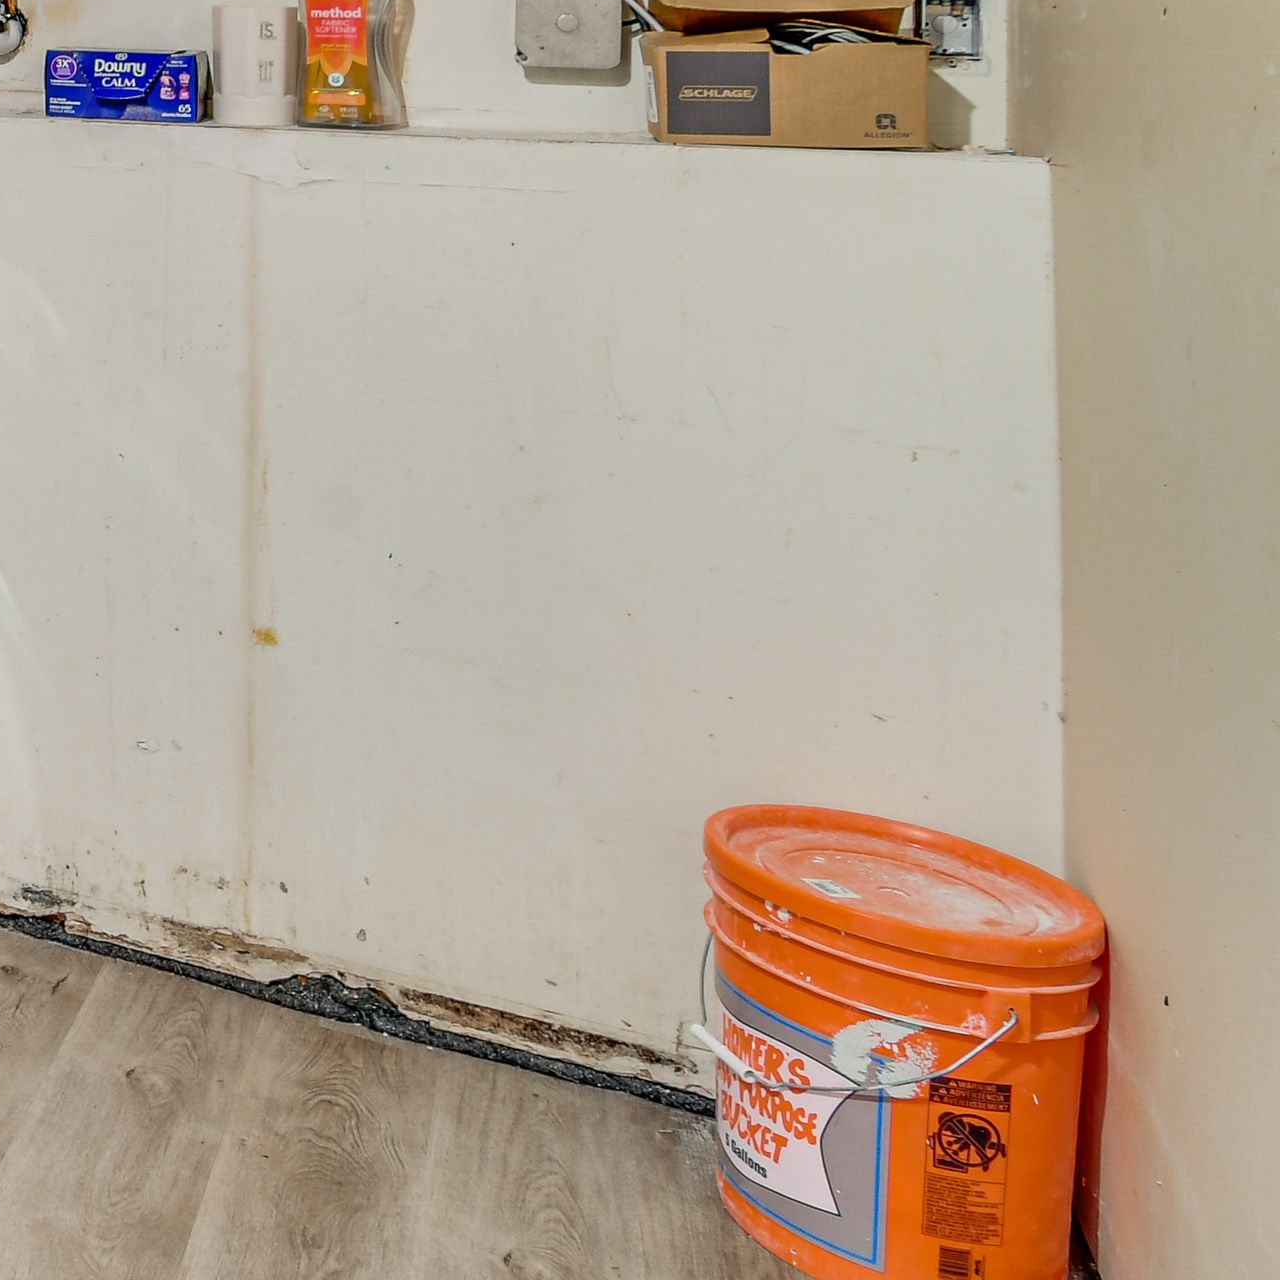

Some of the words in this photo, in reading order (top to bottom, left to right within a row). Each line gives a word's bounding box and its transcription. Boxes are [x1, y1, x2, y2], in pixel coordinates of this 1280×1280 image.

[310, 7, 362, 18] method
[314, 26, 357, 34] SOFTENER
[94, 59, 147, 77] Downy
[102, 77, 136, 87] CALM
[682, 89, 754, 98] SCHLAGE
[178, 105, 191, 113] 65
[863, 131, 911, 139] ALLEGION
[722, 1012, 811, 1094] HOMER'S
[739, 1081, 818, 1146] PURPOSE
[720, 1089, 789, 1164] BUCKET
[725, 1132, 730, 1147] 5
[731, 1139, 768, 1179] Gallons
